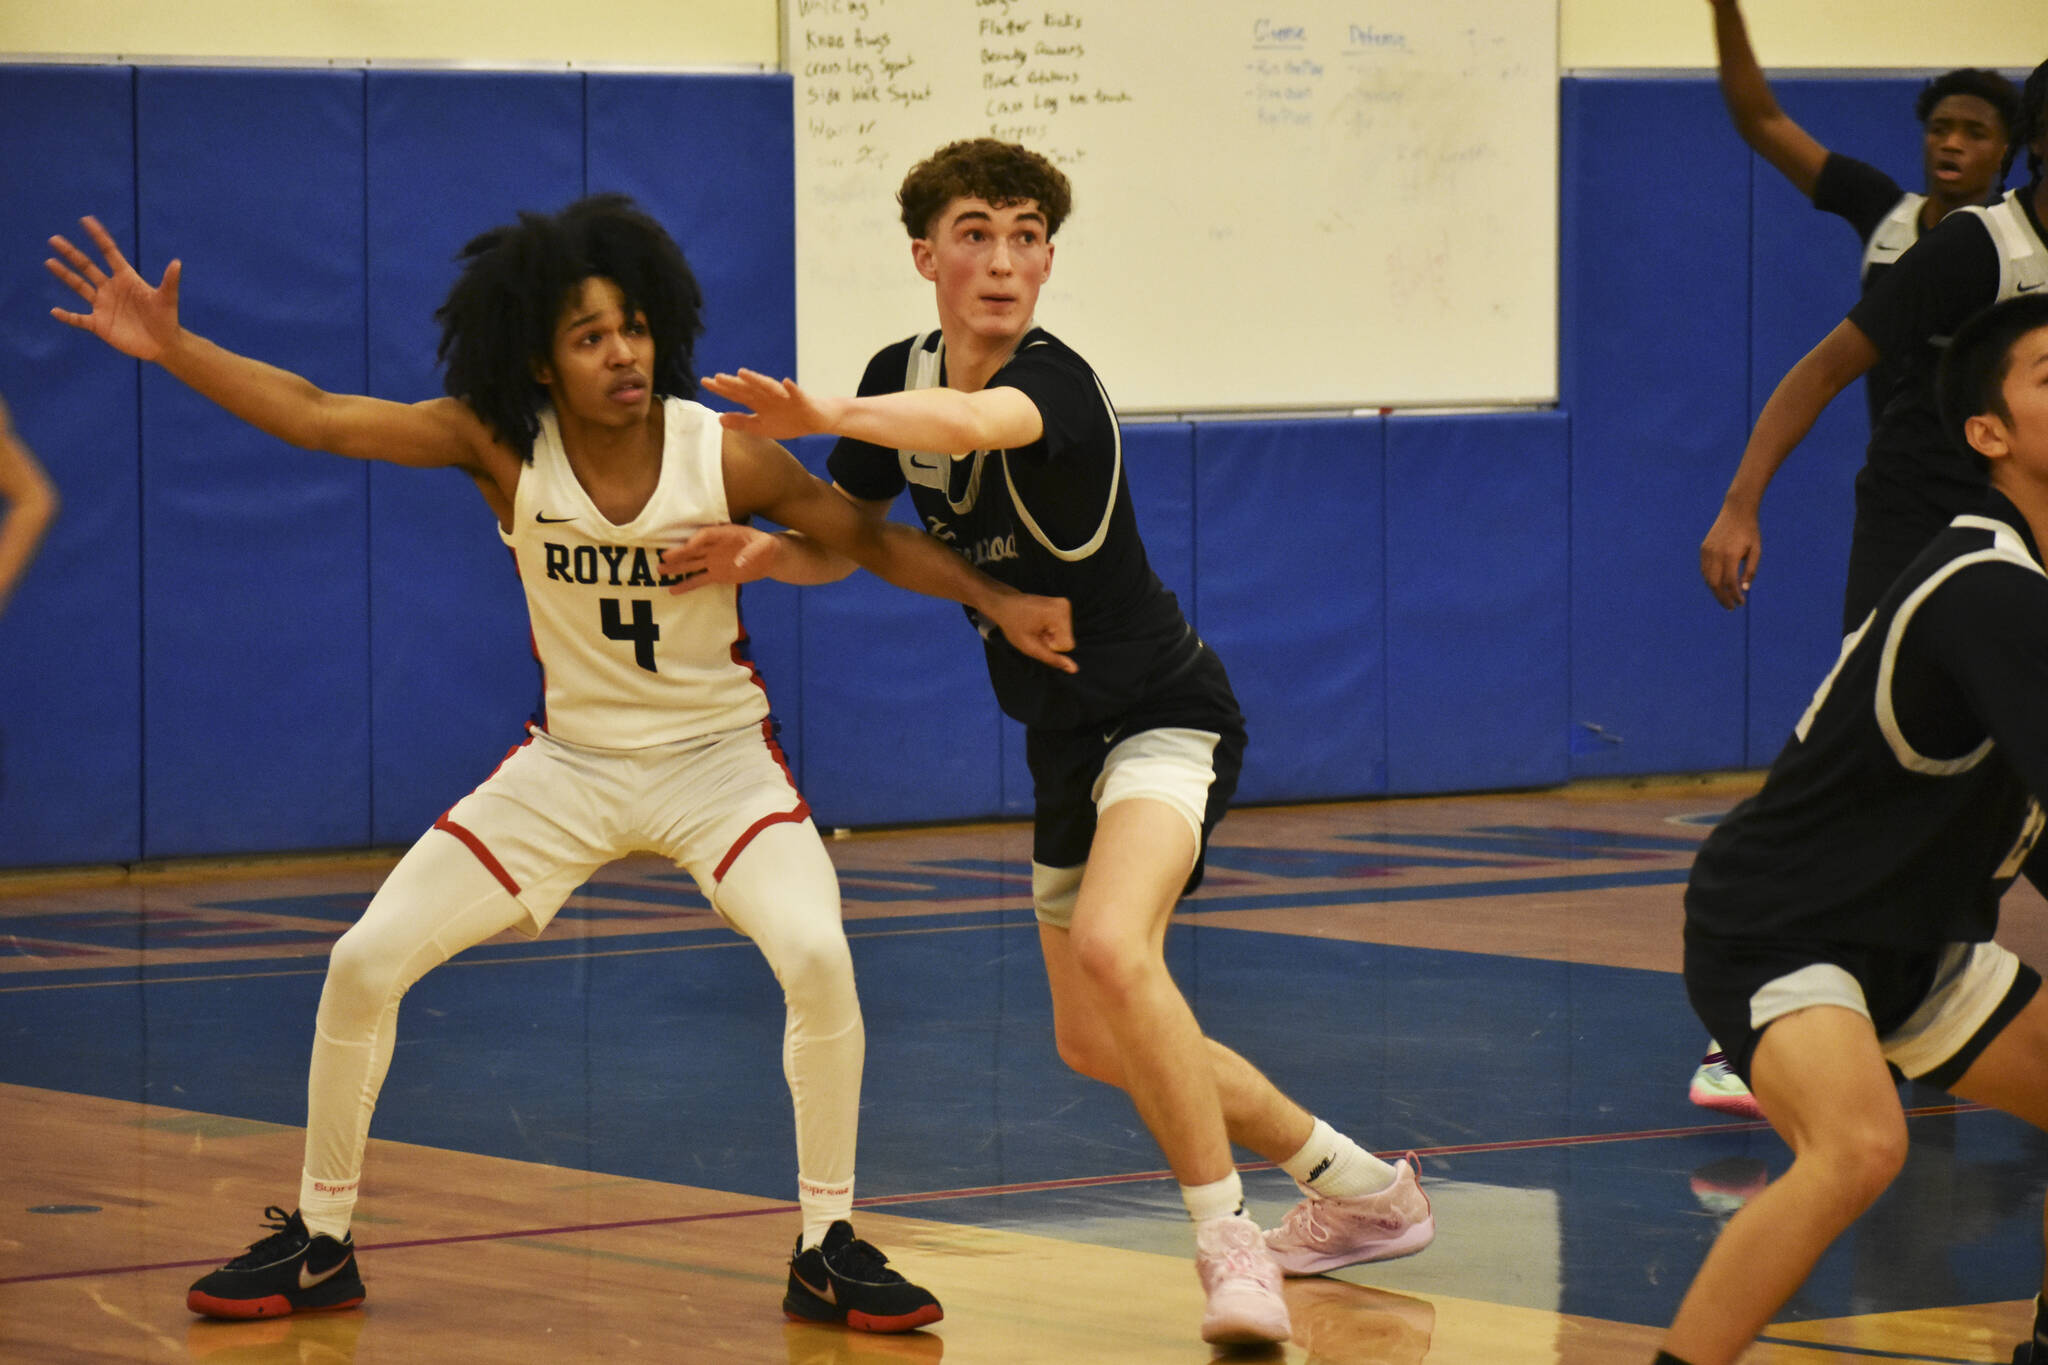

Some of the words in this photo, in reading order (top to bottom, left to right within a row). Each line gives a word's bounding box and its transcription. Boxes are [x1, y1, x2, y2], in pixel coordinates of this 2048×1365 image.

[805, 29, 845, 51] Knee
[543, 541, 709, 588] ROYAL
[599, 597, 660, 674] 4
[1309, 1156, 1330, 1180] NIKE
